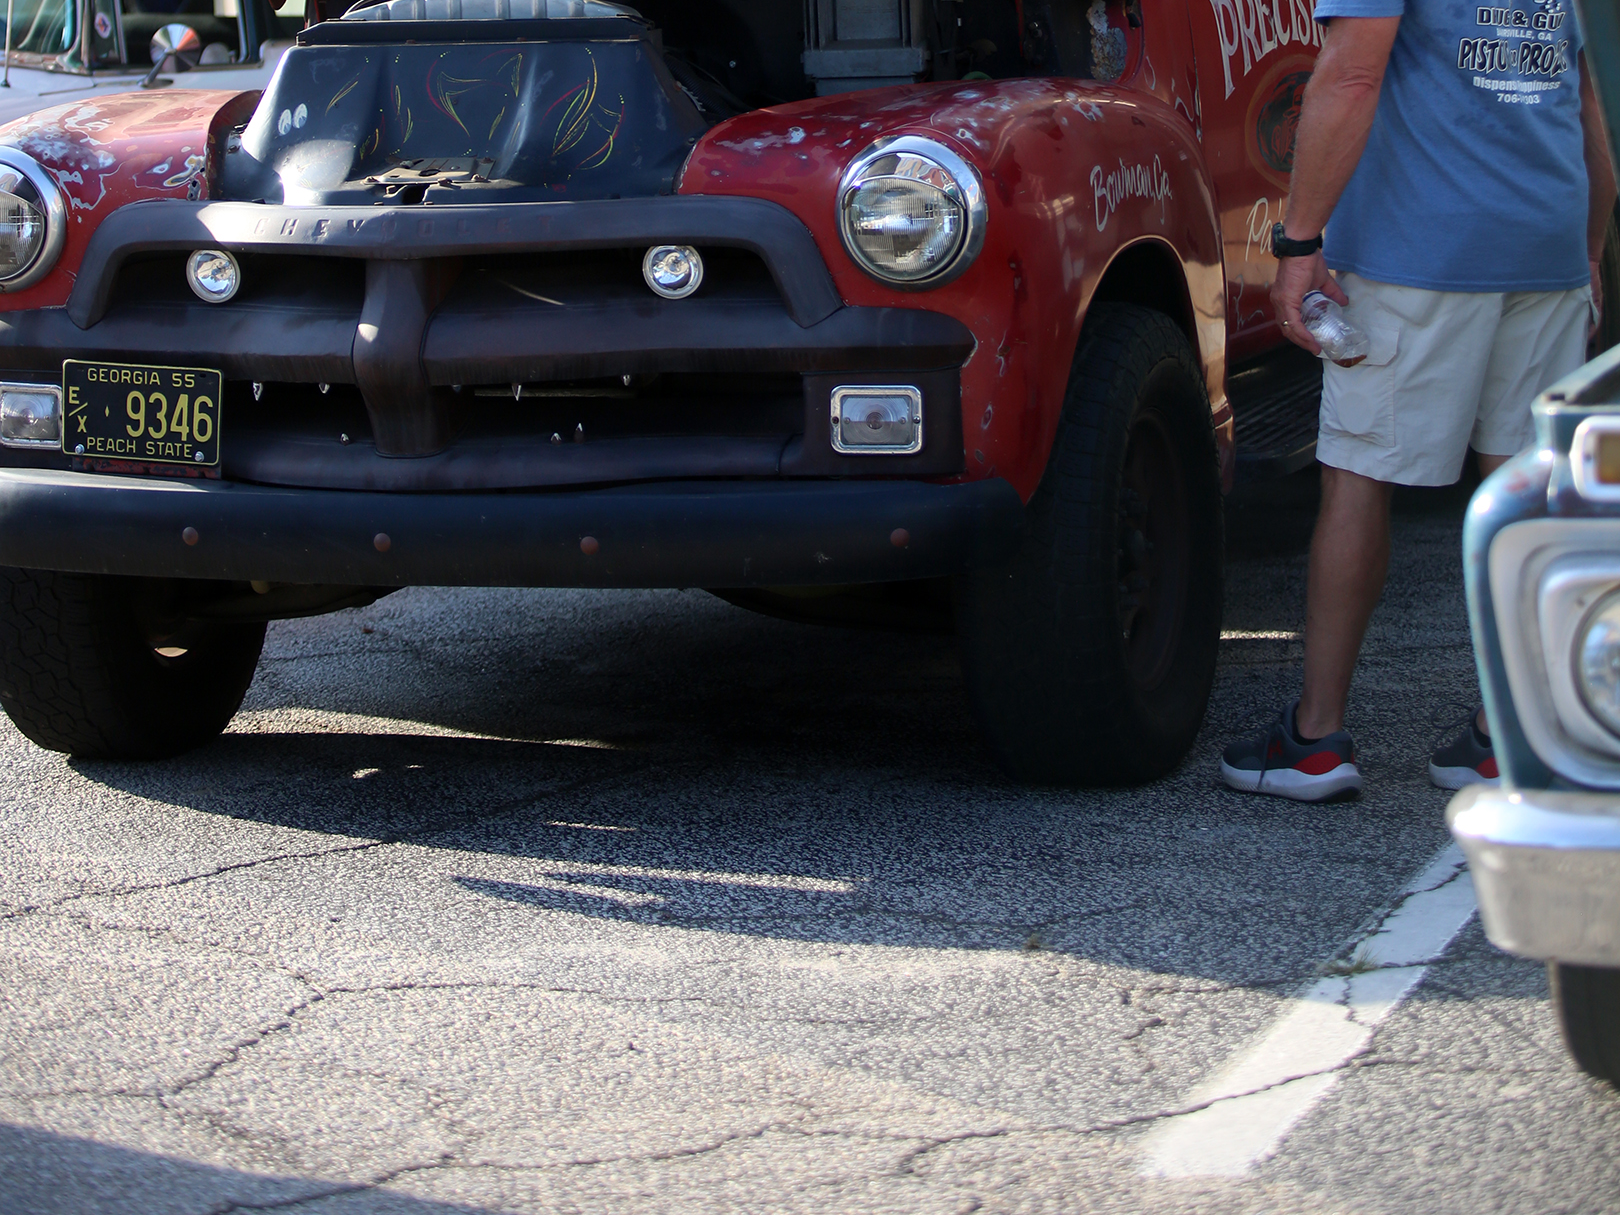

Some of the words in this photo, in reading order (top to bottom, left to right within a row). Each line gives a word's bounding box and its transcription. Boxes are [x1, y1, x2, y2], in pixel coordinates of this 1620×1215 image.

[1511, 10, 1529, 28] &
[1537, 31, 1552, 42] GA
[252, 214, 557, 238] CHEVROLET
[87, 367, 161, 386] GEORGIA
[171, 372, 196, 389] 55
[125, 390, 214, 443] 9346
[86, 436, 137, 454] PEACH
[145, 441, 193, 458] STATE
